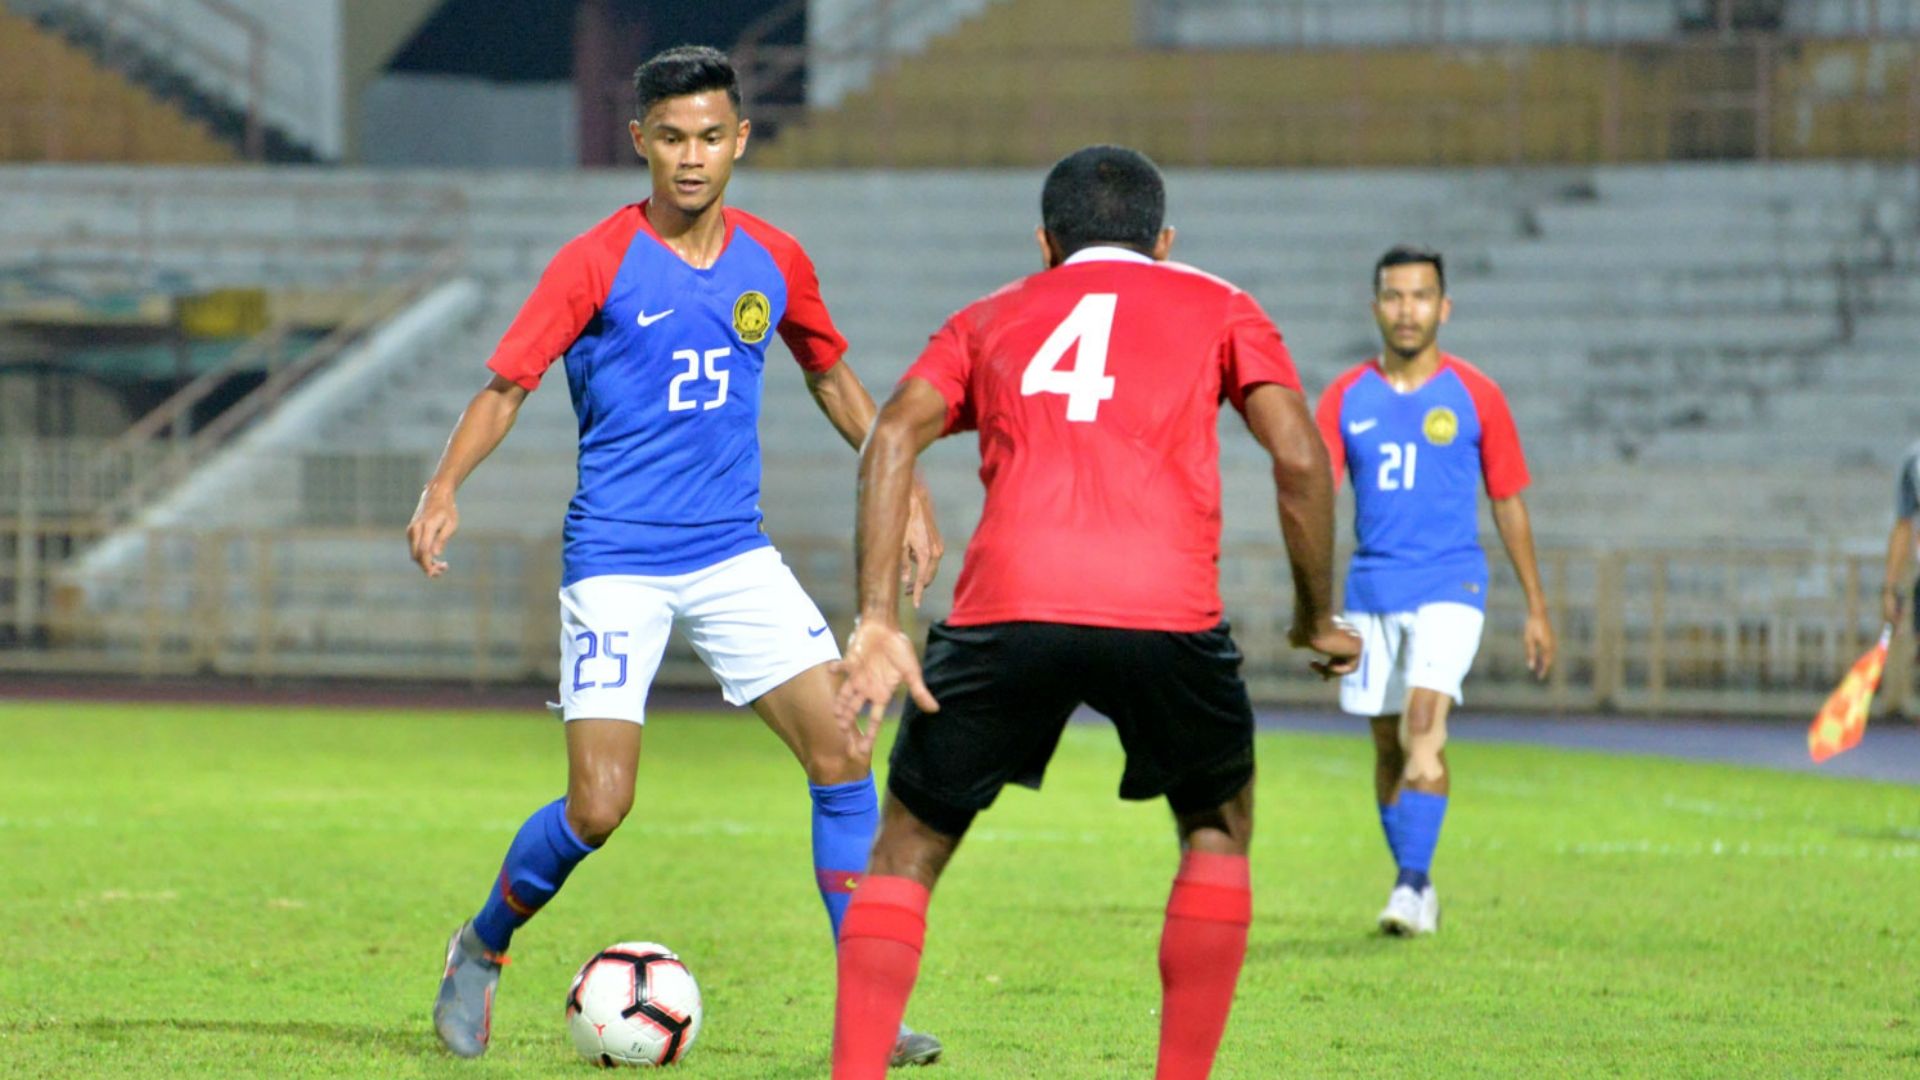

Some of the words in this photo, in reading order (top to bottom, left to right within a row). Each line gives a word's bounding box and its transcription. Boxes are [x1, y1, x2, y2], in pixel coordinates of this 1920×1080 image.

[668, 347, 731, 412] 25
[1020, 293, 1118, 422] 4
[1378, 442, 1417, 491] 21
[573, 631, 629, 692] 25
